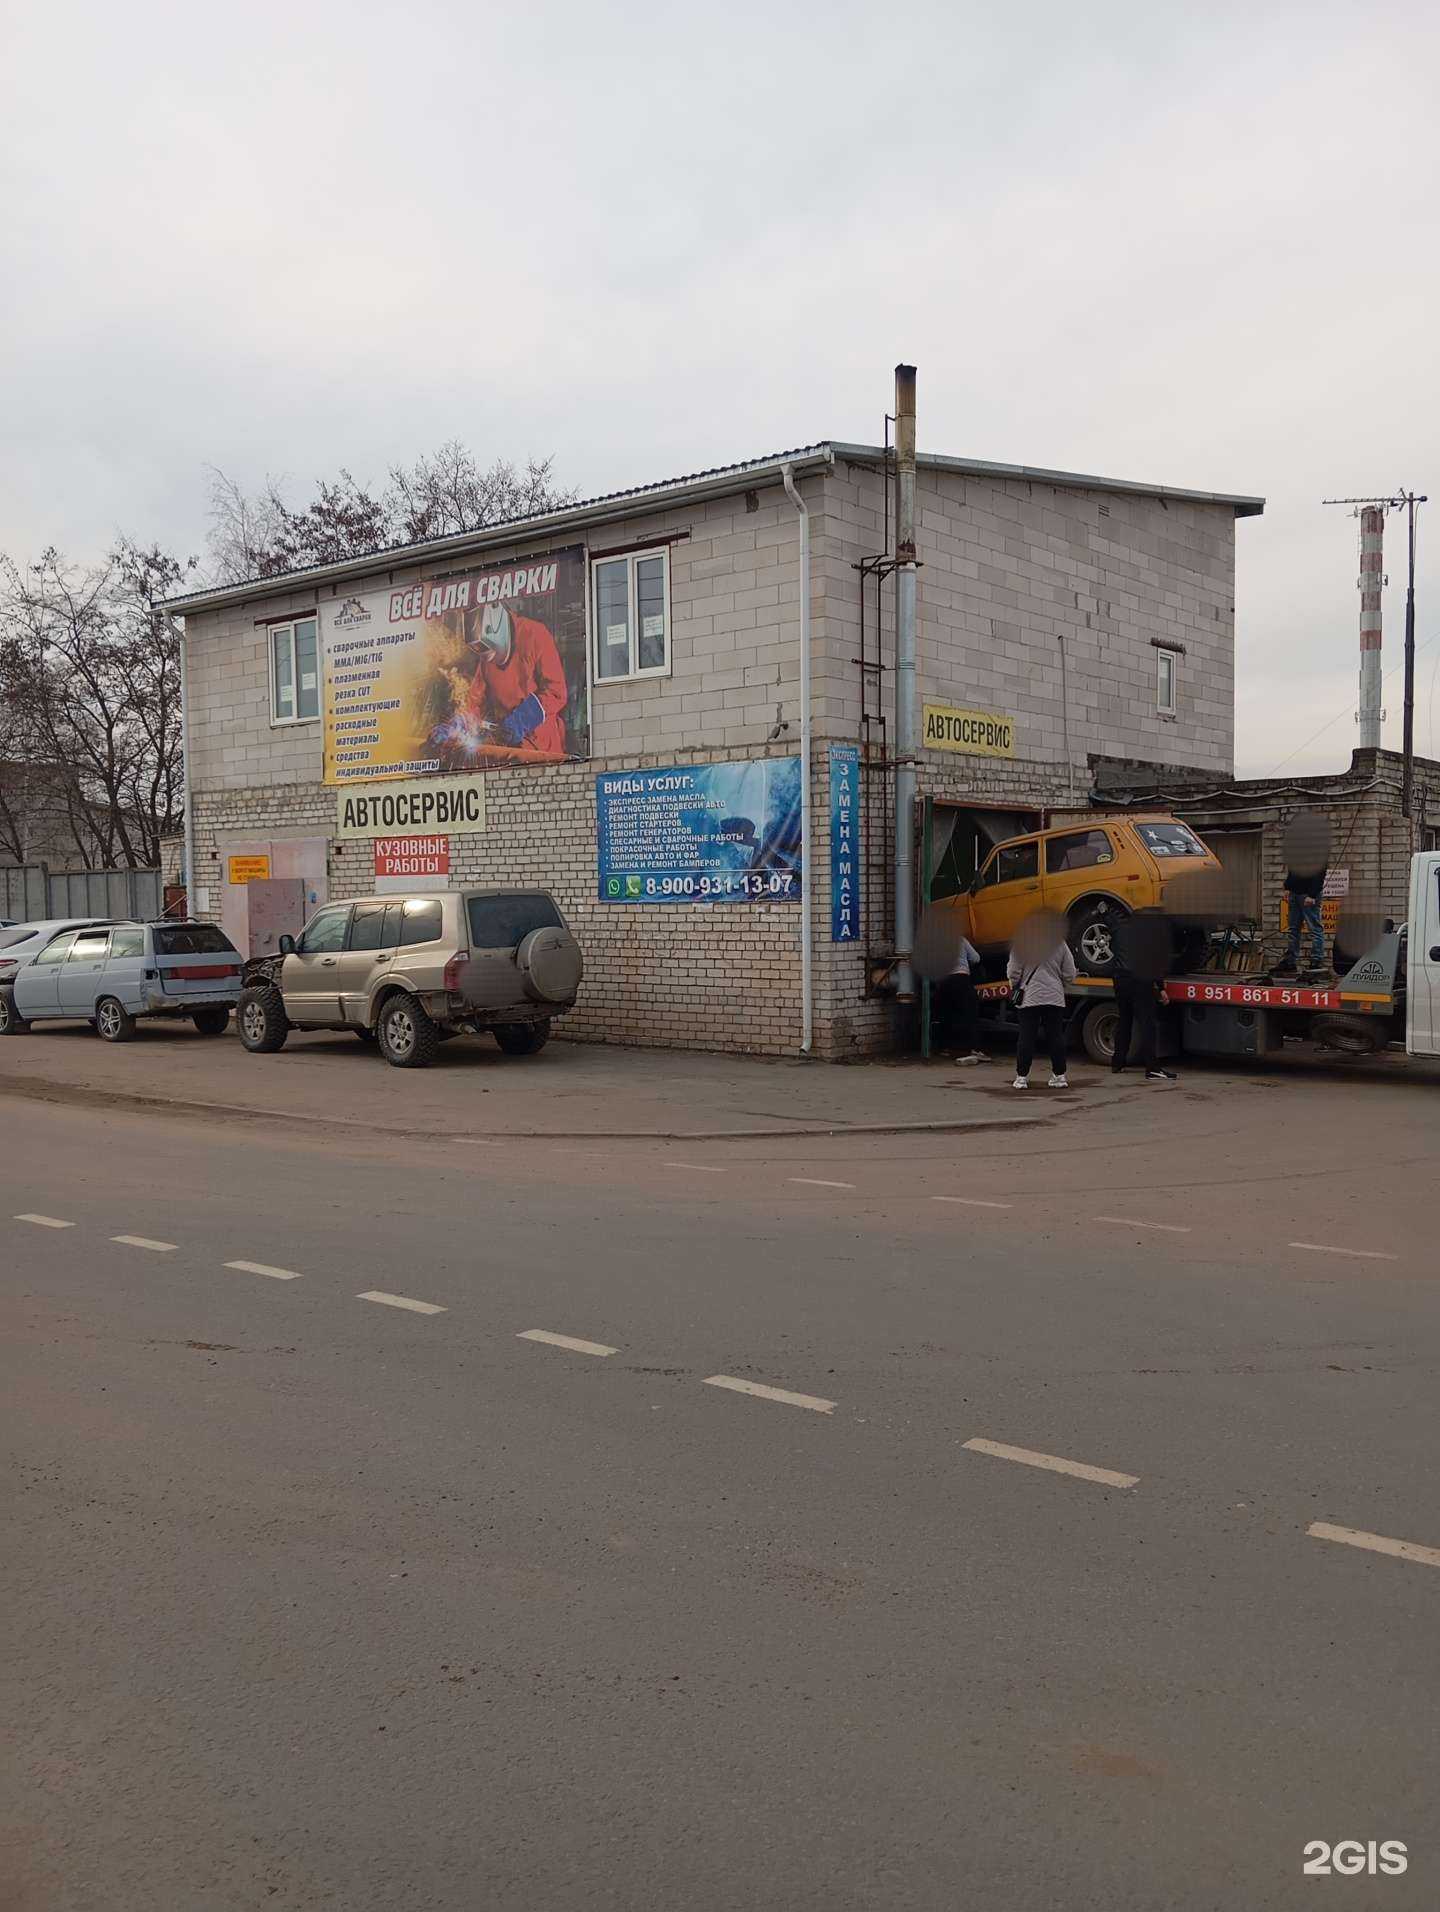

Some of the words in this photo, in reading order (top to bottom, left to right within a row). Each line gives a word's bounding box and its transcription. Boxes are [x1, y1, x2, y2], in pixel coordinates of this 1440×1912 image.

[390, 586, 423, 621] ВСЁ
[427, 581, 470, 619] ДЛЯ
[476, 563, 558, 604] СВАРКИ
[333, 638, 375, 653] сварочные
[376, 631, 416, 646] аппараты
[334, 651, 383, 669] MMA/MIG/TIG
[334, 670, 381, 684] плазменная
[335, 689, 356, 701] резка
[358, 685, 371, 696] CUT
[335, 699, 400, 715] комплектующие
[335, 718, 377, 732] расходные
[926, 713, 1010, 749] АВТОСЕРВИС
[336, 734, 379, 746] материалы
[336, 750, 369, 762] средства
[336, 761, 404, 777] индивидуальной
[405, 759, 439, 772] защиты
[603, 780, 644, 795] ВИДЫ
[647, 775, 694, 791] УСЛУГ:
[343, 788, 480, 828] АВТОСЕРВИС
[608, 797, 646, 807] ЭКСПРЕСС
[647, 795, 677, 804] ЗАМЕНА
[680, 793, 706, 801] МАСЛА
[608, 804, 661, 815] ДИАГНОСТИКА
[662, 801, 703, 811] ПОДВЕСКИ
[705, 799, 726, 809] АВТО
[608, 813, 638, 822] РЕМОНТ
[639, 811, 679, 820] ПОДВЕСКИ
[838, 763, 851, 854] ЗАМЕНА
[608, 821, 638, 830] РЕМОНТ
[639, 819, 682, 828] СТАРТЕРОВ
[609, 829, 638, 838] РЕМОНТ
[639, 827, 692, 837] ГЕНЕРАТОРОВ
[609, 837, 653, 846] СЛЕСАРНЫЕ
[654, 836, 660, 844] И
[661, 834, 709, 843] СВАРОЧНЫЕ
[710, 832, 744, 842] РАБОТЫ
[376, 838, 448, 857] КУЗОВНЫЕ
[610, 844, 664, 854] ПОКРАСОЧНЫЕ
[665, 843, 698, 852] РАБОТЫ
[610, 853, 653, 862] ПОЛИРОВКА
[654, 852, 675, 860] АВТО
[676, 852, 681, 860] И
[683, 851, 699, 860] ФАР
[611, 861, 639, 869] ЗАМЕНА
[647, 860, 678, 868] РЕМОНТ
[679, 859, 720, 868] БАМПЕРОВ
[385, 857, 439, 873] РАБОТЫ
[646, 874, 793, 895] 8-900-931-13-07
[839, 862, 851, 937] МАСЛА
[1187, 985, 1196, 998] 8
[1204, 986, 1231, 1000] 951
[1242, 988, 1270, 1002] 861
[1281, 990, 1299, 1004] 51
[1311, 991, 1329, 1006] 11
